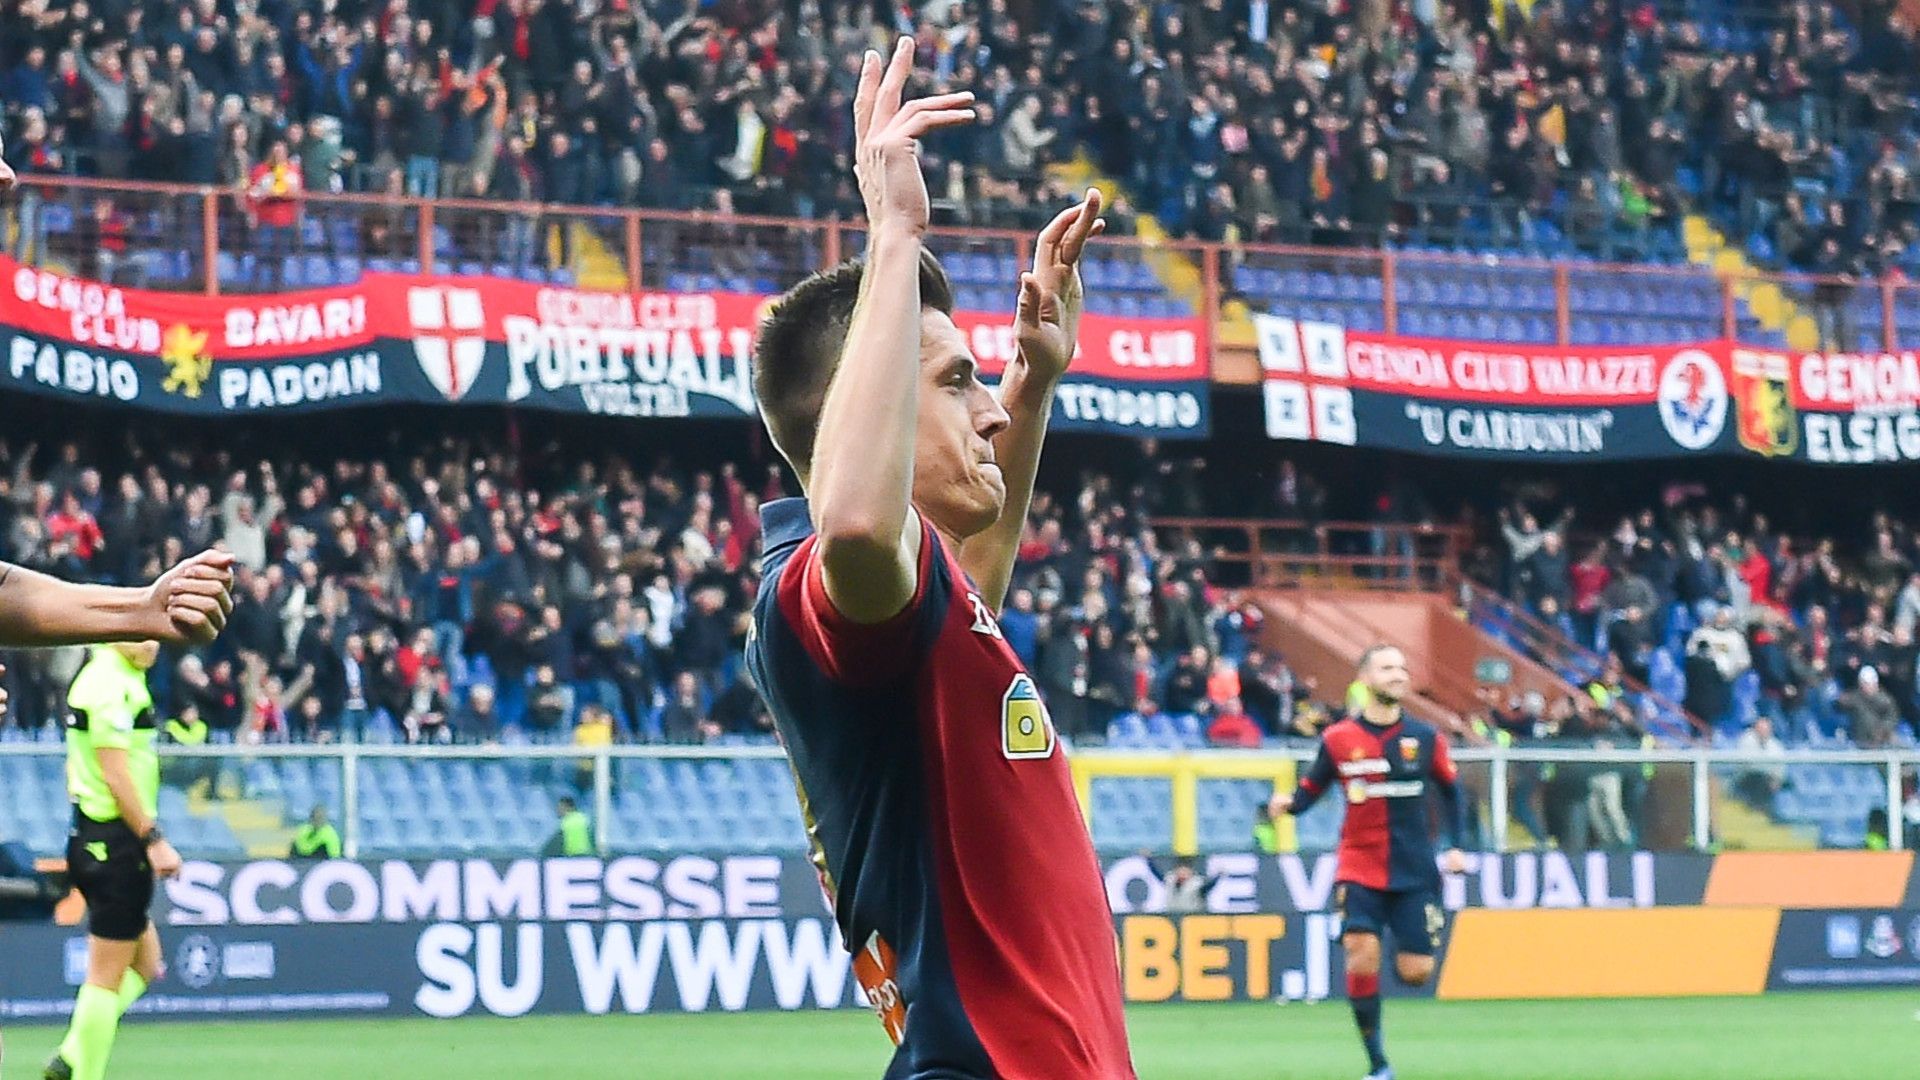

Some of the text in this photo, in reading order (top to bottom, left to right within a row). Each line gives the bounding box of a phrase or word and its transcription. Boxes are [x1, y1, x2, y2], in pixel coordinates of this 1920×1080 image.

[14, 267, 124, 316] GENOA
[225, 295, 367, 348] BAVARI
[9, 335, 139, 401] FABIO
[218, 351, 382, 410] PADOAN
[1349, 341, 1450, 388] GENOA
[165, 857, 783, 926] SCOMMESSE
[415, 921, 544, 1018] SU
